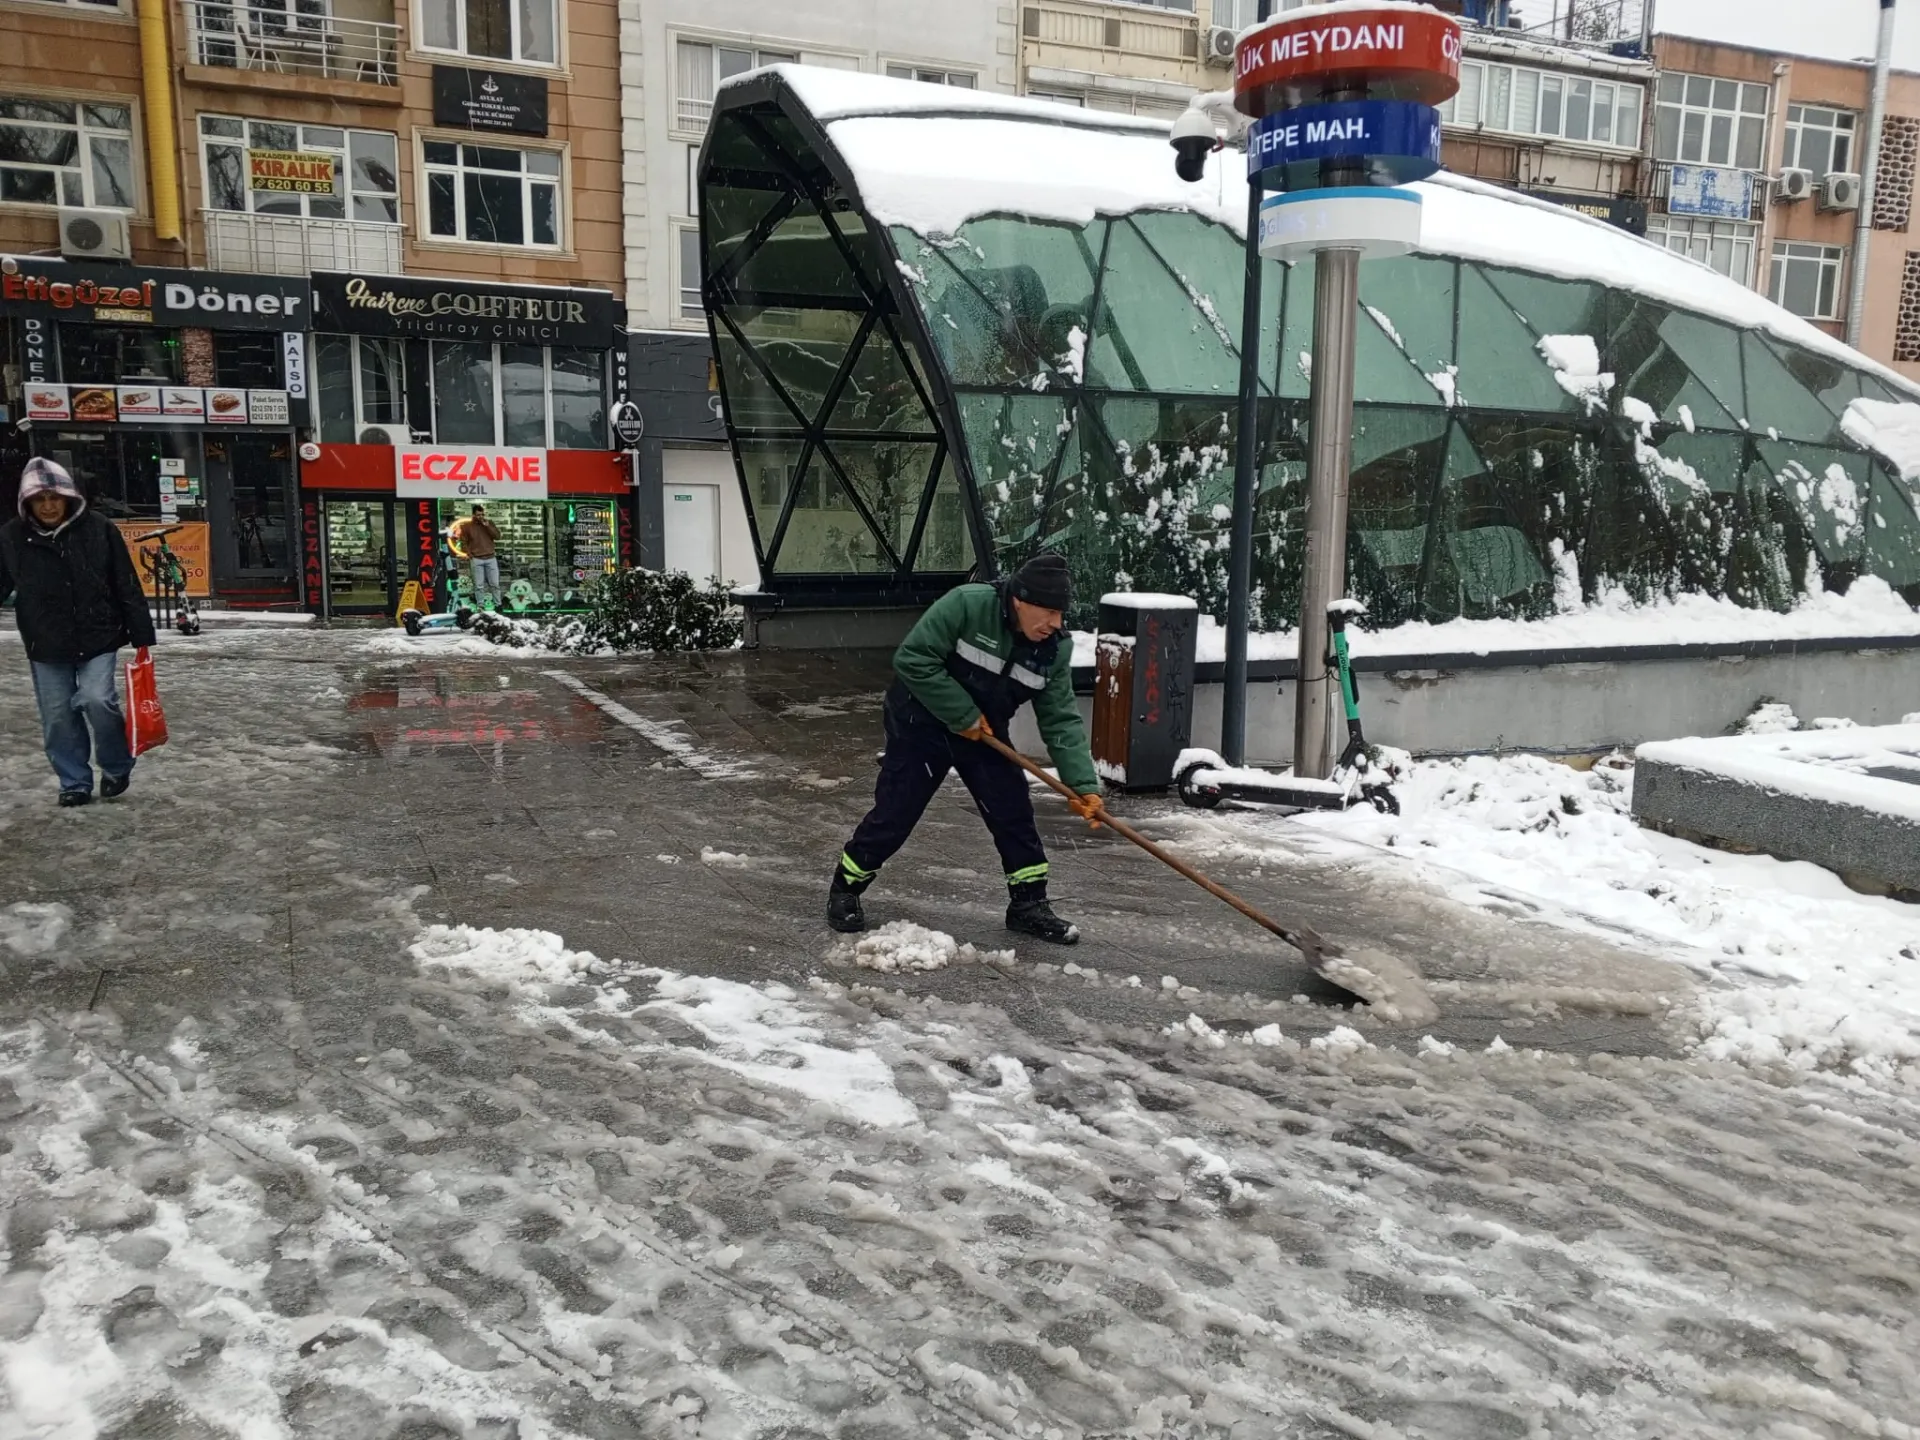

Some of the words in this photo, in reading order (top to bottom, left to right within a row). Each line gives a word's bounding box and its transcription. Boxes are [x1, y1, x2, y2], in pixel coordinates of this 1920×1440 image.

[1271, 24, 1404, 63] MEYDANI
[1441, 27, 1462, 65] ÖZ
[1306, 117, 1371, 143] MAH.
[251, 160, 333, 180] KIRALIK
[267, 179, 291, 190] 620
[295, 181, 311, 191] 60
[314, 182, 331, 193] 55
[1578, 204, 1610, 219] DESIGN
[165, 283, 301, 316] Döner
[431, 291, 587, 324] COIFFEUR
[287, 333, 303, 393] PATSO
[402, 453, 541, 482] ECZANE
[458, 482, 488, 495] ÖZİL
[303, 502, 321, 605] ECZANE
[418, 501, 434, 602] ECZANE
